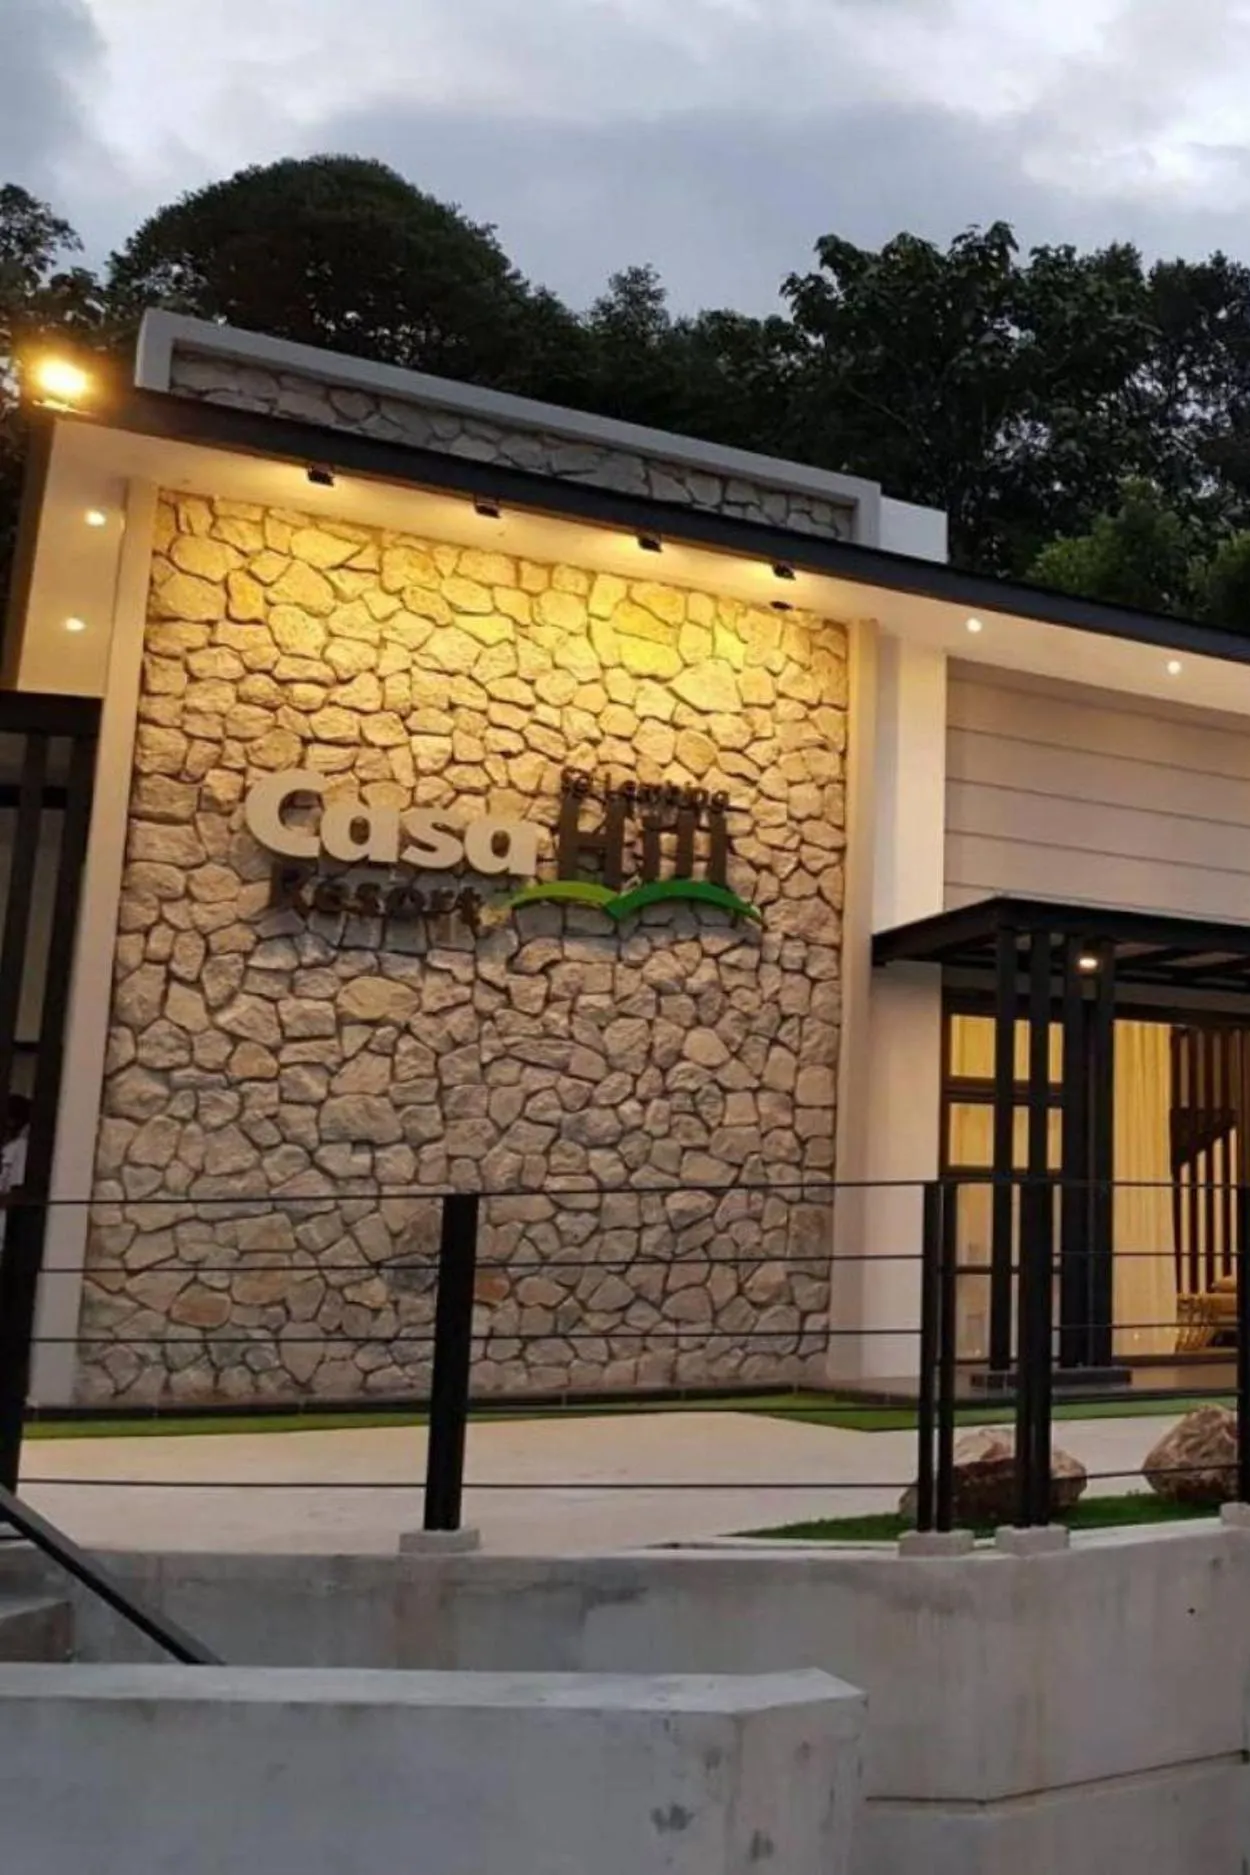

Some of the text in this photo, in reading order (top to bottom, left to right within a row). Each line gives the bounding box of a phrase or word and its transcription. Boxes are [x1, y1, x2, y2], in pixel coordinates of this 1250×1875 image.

[245, 769, 730, 893] Casa Hill
[269, 860, 483, 927] Resort
